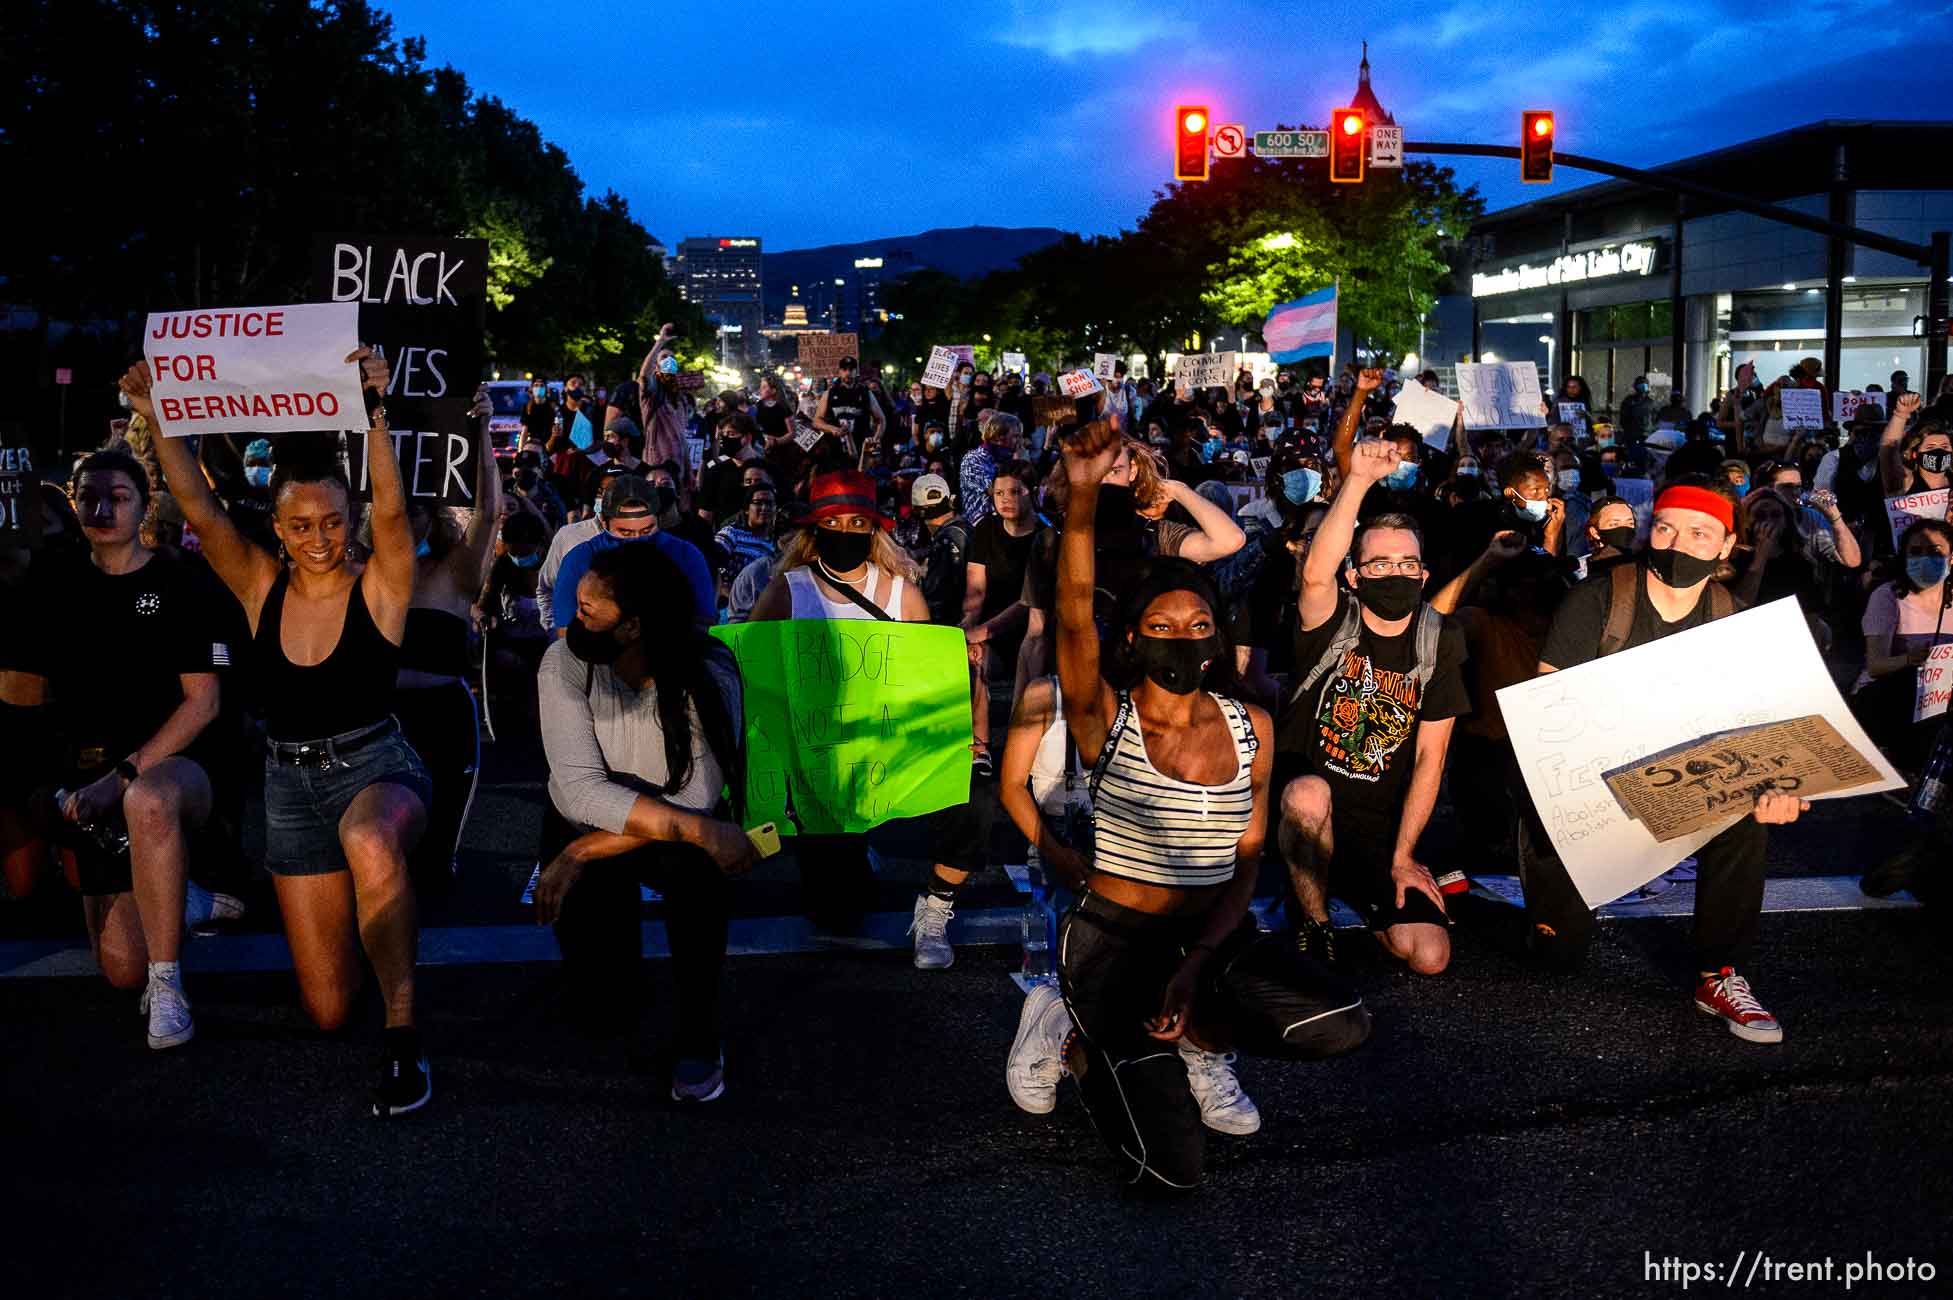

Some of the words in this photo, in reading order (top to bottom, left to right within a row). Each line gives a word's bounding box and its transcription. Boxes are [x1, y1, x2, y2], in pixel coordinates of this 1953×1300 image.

[1267, 134, 1291, 146] 600
[1298, 134, 1314, 146] SO
[1376, 140, 1397, 149] WAY
[1377, 129, 1397, 139] ONE
[332, 243, 464, 306] BLACK
[153, 312, 284, 340] JUSTICE
[934, 347, 956, 360] BLACK
[153, 354, 217, 382] FOR
[924, 371, 950, 384] MATTER
[930, 361, 951, 373] LIVES
[160, 391, 339, 422] BERNARDO
[1890, 493, 1948, 511] JUSTICE
[795, 631, 905, 687] BADGE
[792, 703, 853, 744] NOT
[880, 703, 902, 738] A
[847, 761, 887, 799] TO
